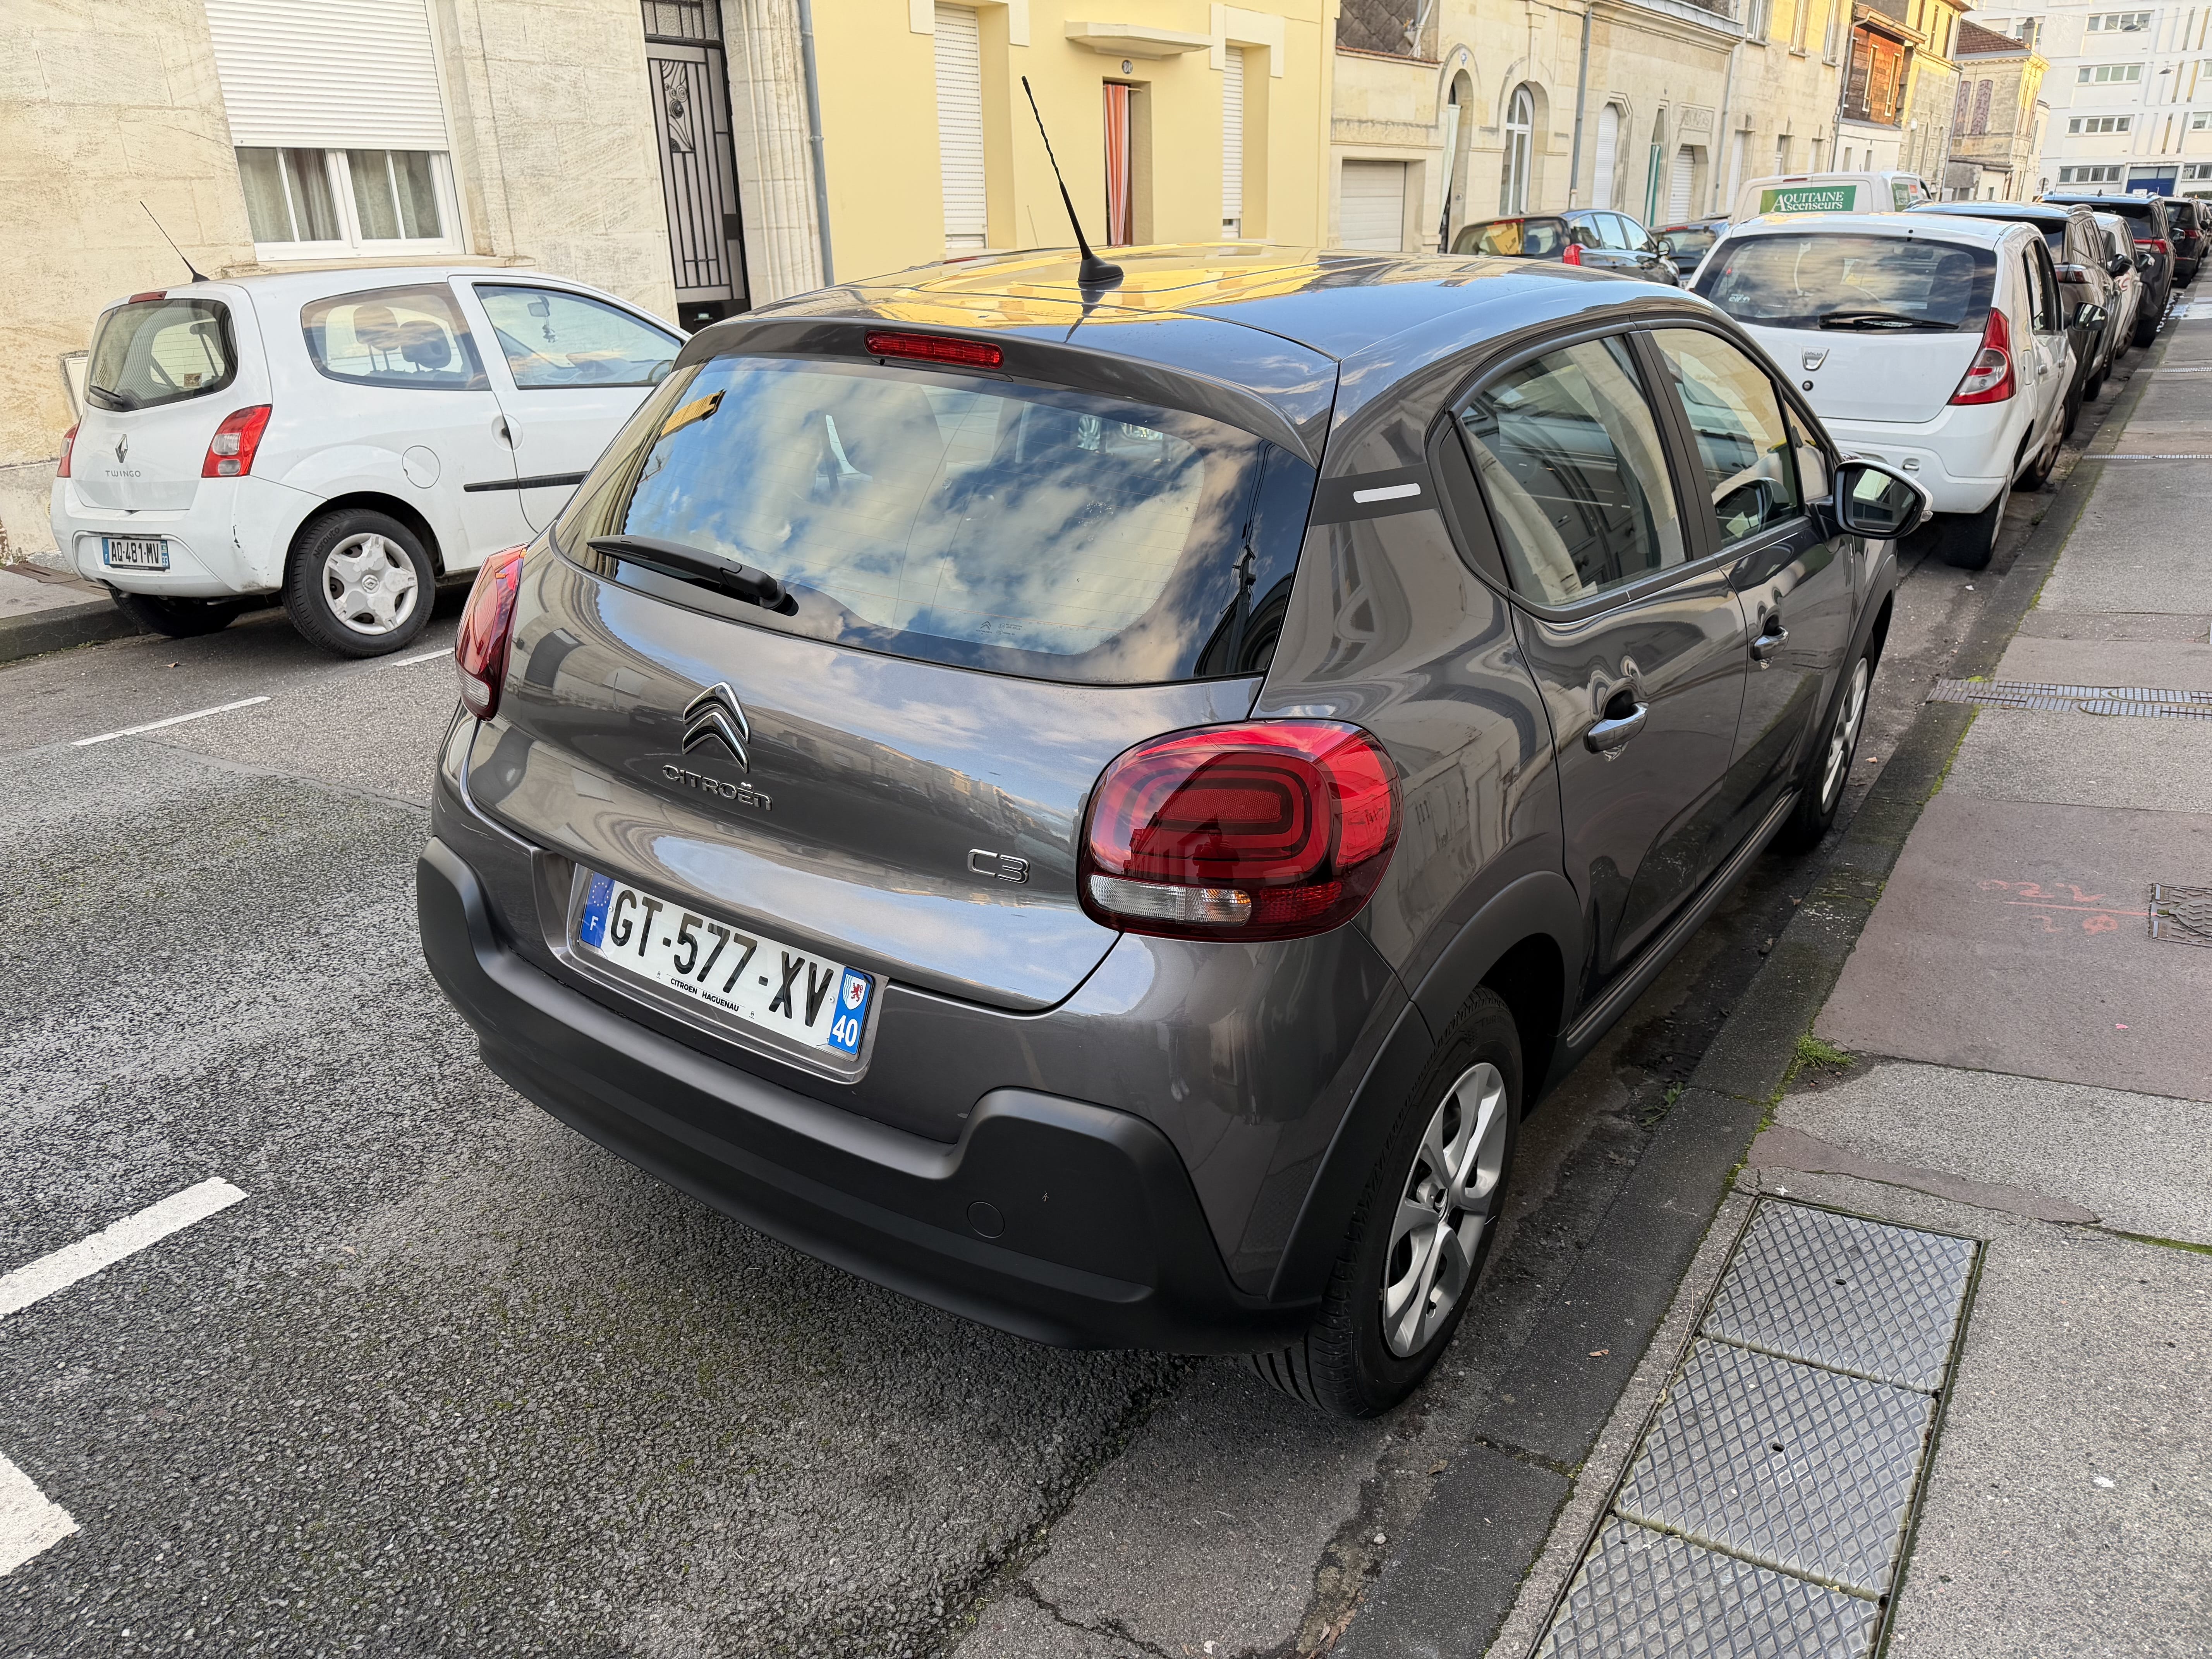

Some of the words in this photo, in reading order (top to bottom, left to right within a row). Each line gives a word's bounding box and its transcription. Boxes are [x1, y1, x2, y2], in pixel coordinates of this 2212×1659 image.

[1771, 191, 1844, 206] AQUITAINE
[111, 541, 159, 563] AQ-481-MV
[313, 527, 340, 558] Norauto
[162, 555, 168, 565] 33
[967, 848, 1030, 883] C3
[589, 915, 599, 931] F
[611, 890, 834, 1028] GT-577-XV
[670, 978, 697, 995] CITROEN
[702, 991, 739, 1012] HAGUENAU
[832, 1015, 858, 1047] 40
